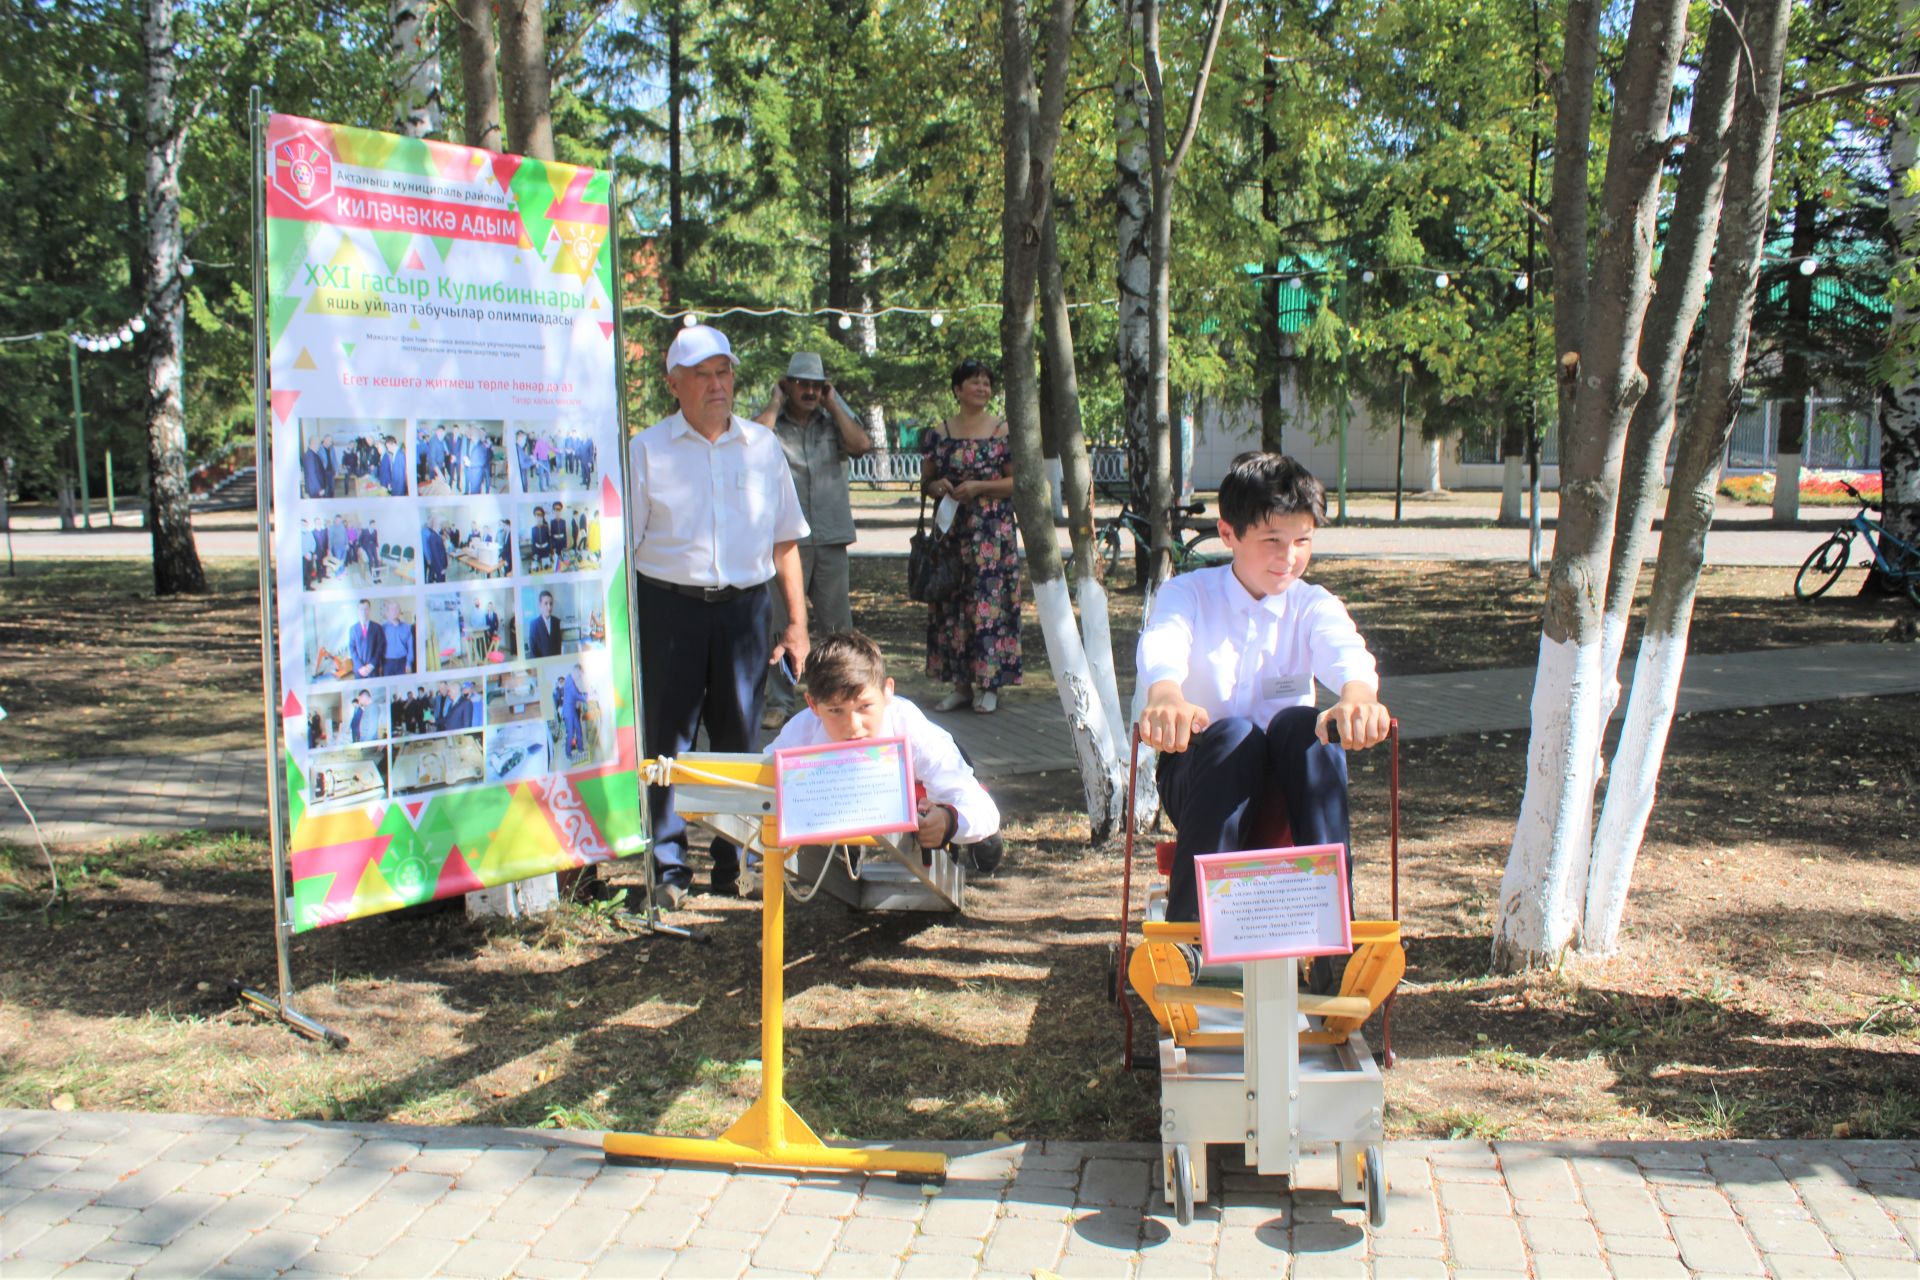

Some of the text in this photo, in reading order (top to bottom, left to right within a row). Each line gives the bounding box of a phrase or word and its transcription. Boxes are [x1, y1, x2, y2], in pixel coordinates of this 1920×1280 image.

[337, 170, 505, 204] Актаныш муниципаль районы
[337, 196, 516, 237] КИЛӘЧӘККӘ АДЫМ
[304, 263, 585, 312] XXI гасыр Кулибиннары
[327, 297, 574, 326] яшь уйлап табучылар олимпиадасы
[343, 372, 369, 386] Егет
[373, 375, 422, 388] кешегә
[425, 377, 474, 390] җитмеш
[478, 379, 509, 392] төрле
[512, 379, 544, 393] һөнәр
